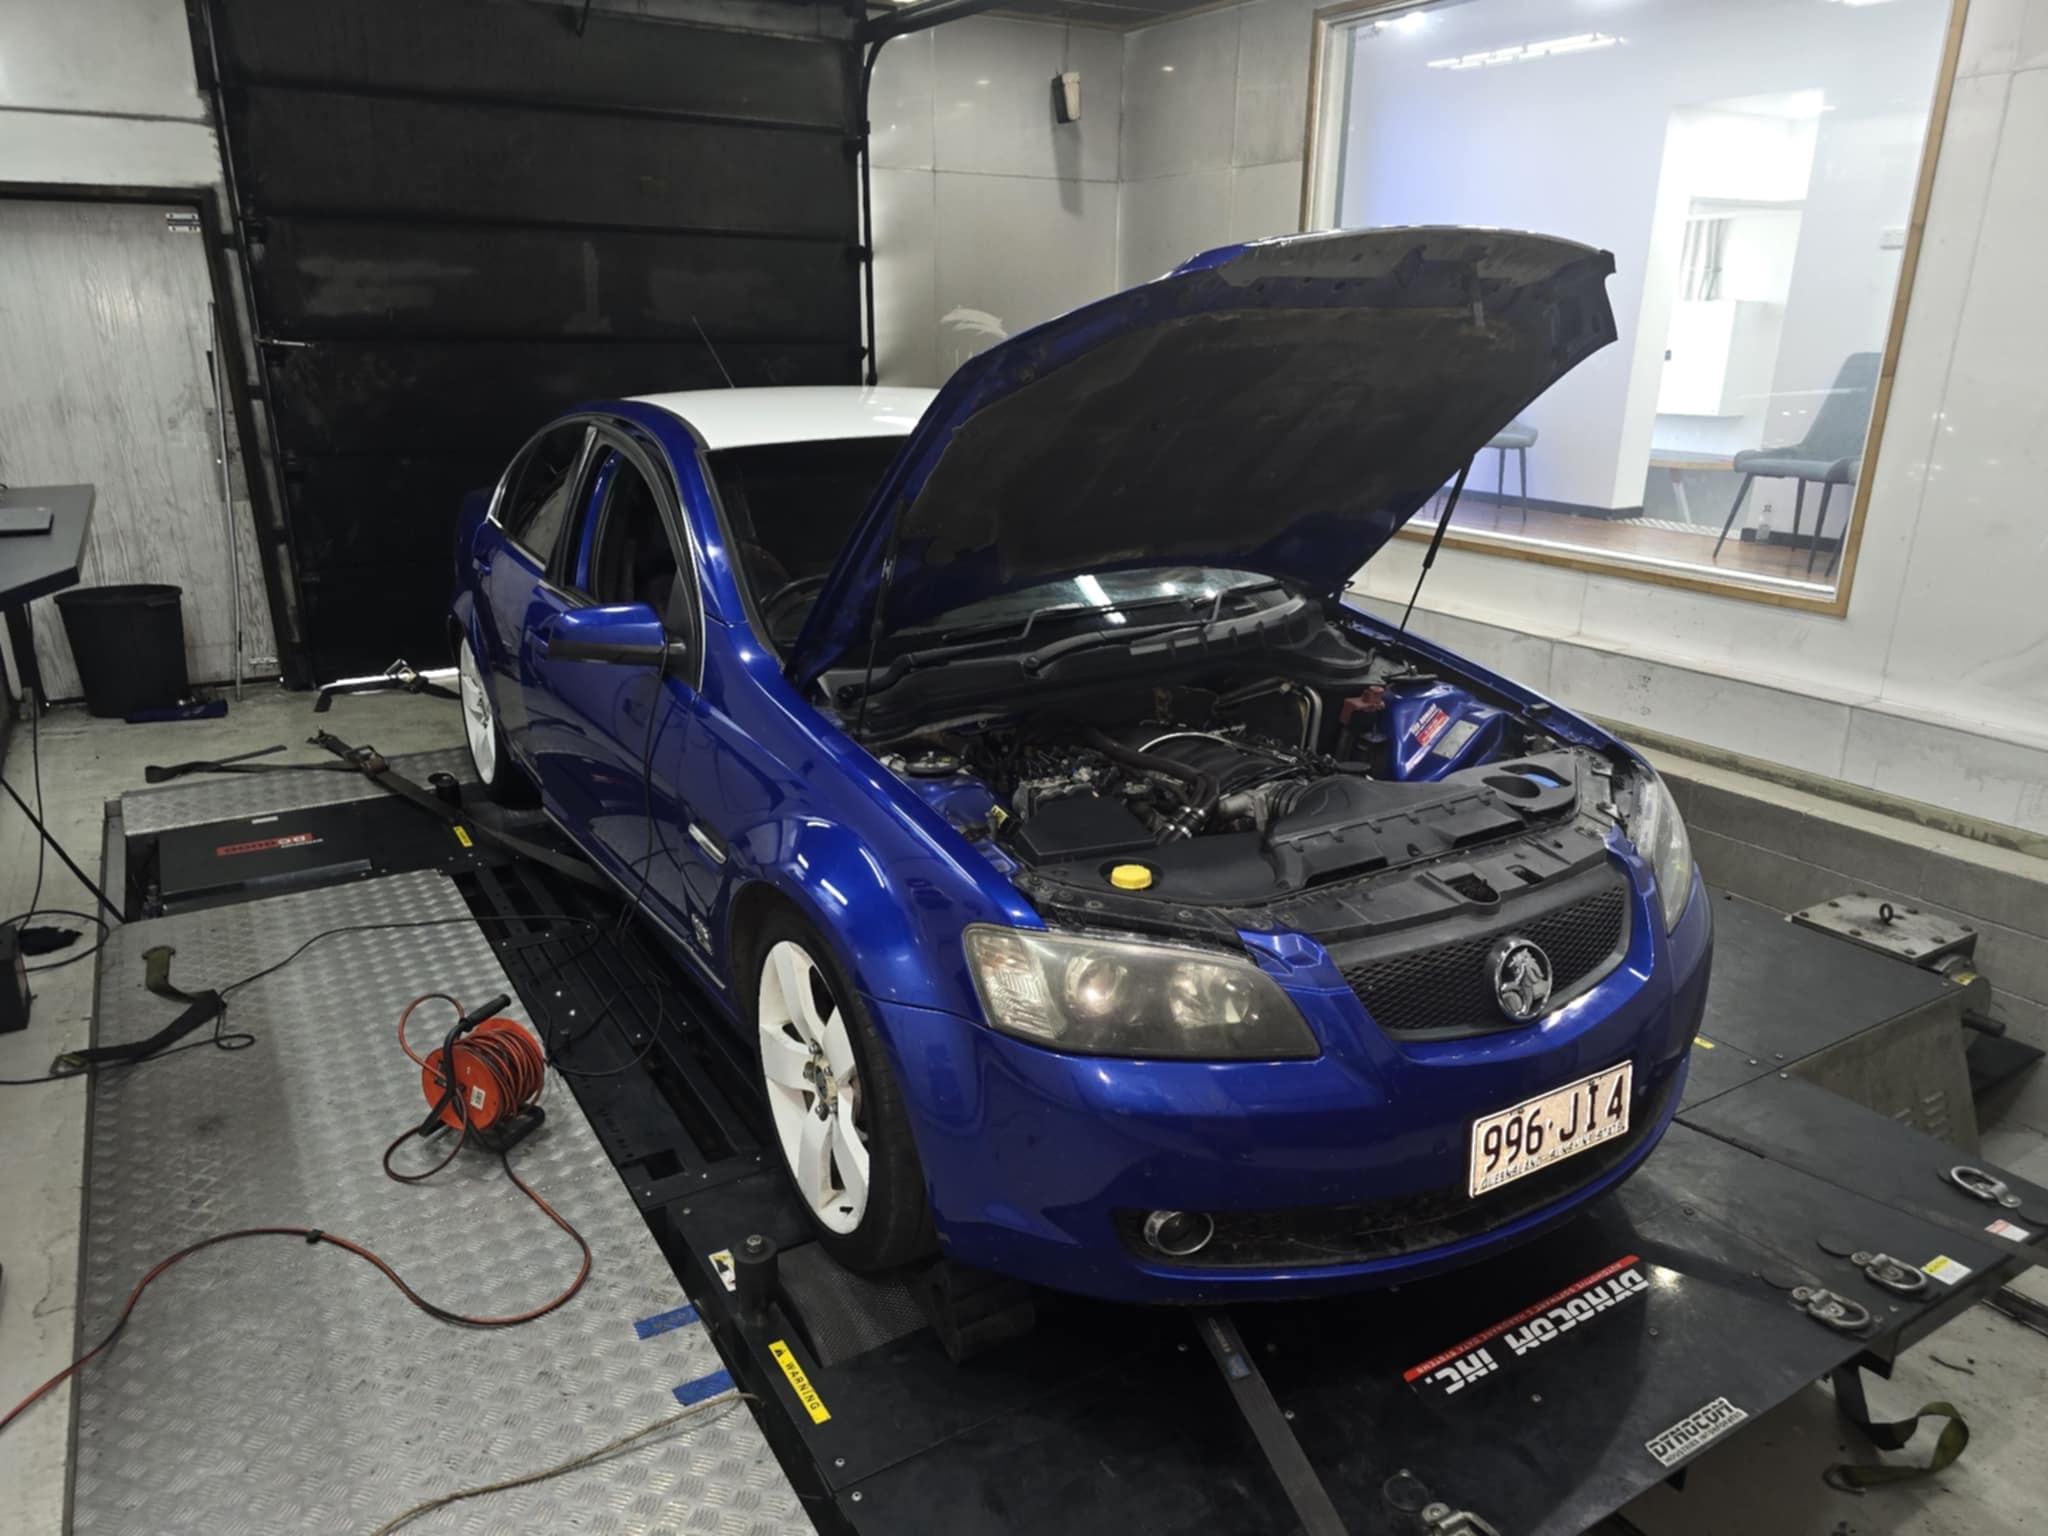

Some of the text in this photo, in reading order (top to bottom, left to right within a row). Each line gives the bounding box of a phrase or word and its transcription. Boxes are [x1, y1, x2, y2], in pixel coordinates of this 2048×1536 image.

[1504, 1269, 1649, 1356] DYNOCOM
[785, 1361, 820, 1410] WARNING
[1648, 1400, 1734, 1459] DYNOCOM
